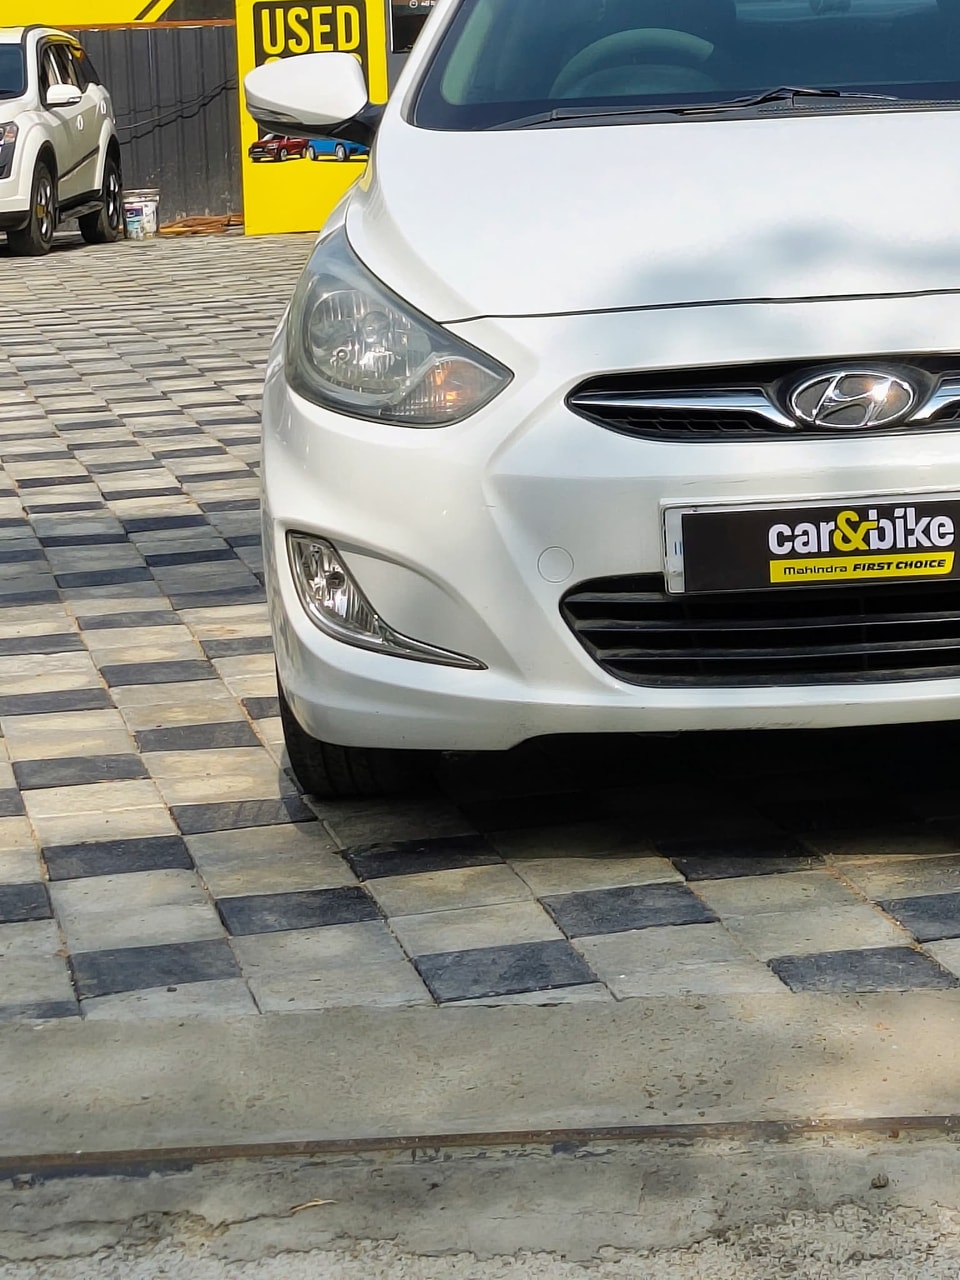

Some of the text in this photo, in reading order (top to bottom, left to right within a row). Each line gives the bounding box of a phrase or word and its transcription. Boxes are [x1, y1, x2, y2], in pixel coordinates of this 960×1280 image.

[261, 4, 361, 55] USED
[768, 507, 955, 555] car&bike
[783, 559, 947, 576] Mahindra FIRST CHOICE
